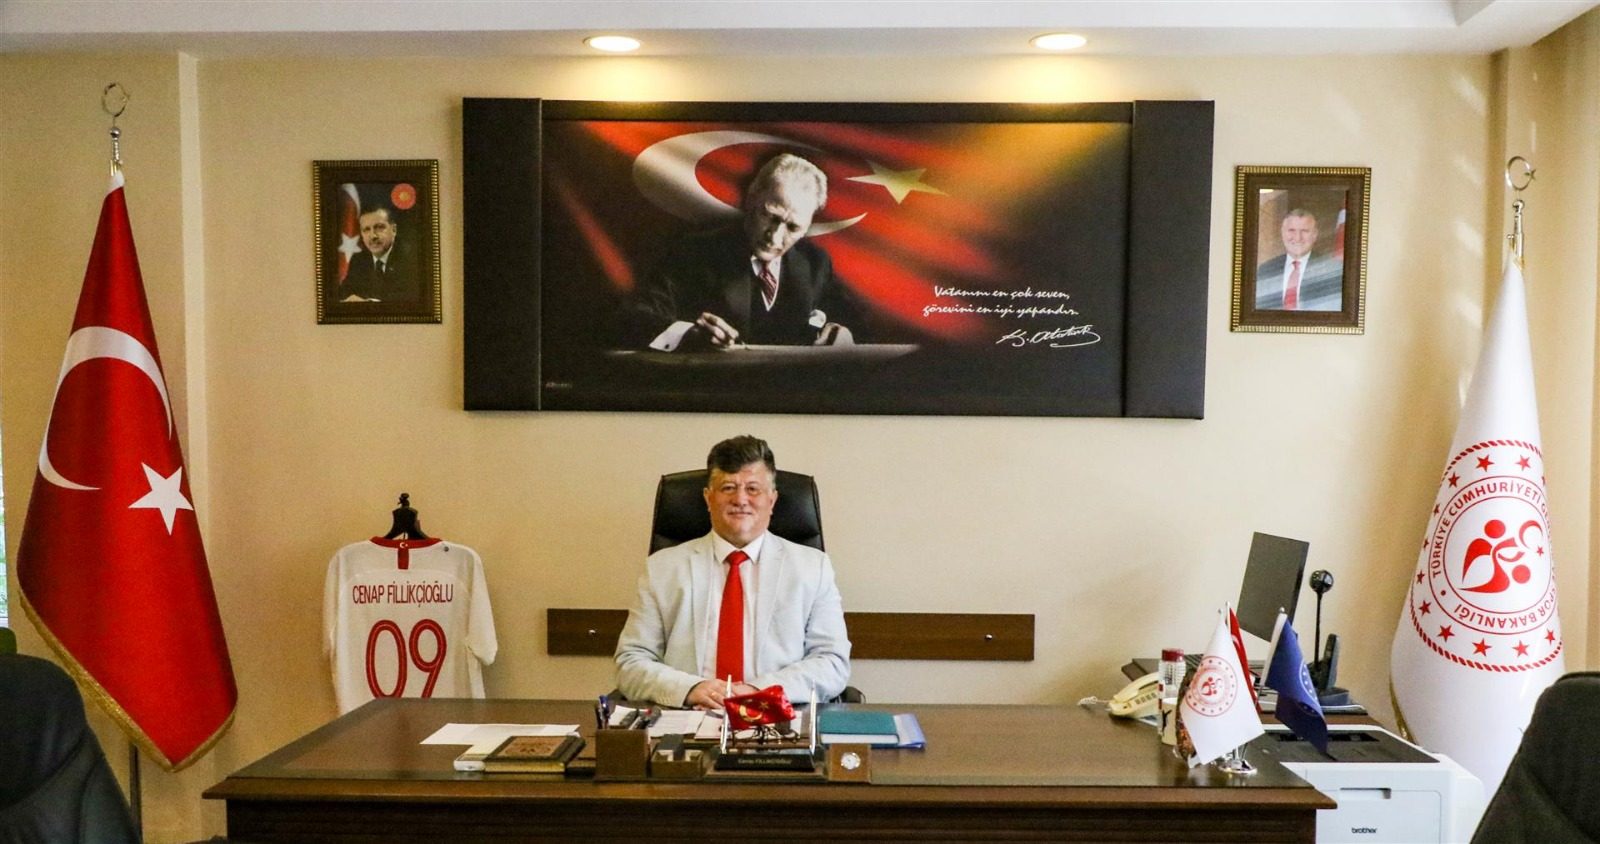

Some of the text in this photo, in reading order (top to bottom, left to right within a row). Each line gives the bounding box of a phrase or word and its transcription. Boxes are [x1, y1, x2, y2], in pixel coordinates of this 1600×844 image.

[992, 289, 1008, 297] en
[1010, 286, 1033, 300] çok
[1034, 290, 1070, 300] seven,
[922, 303, 975, 317] görevini
[976, 306, 992, 314] en
[993, 304, 1015, 318] iyi
[1430, 518, 1451, 579] TÜRKİYE
[1454, 604, 1537, 628] BAKANLIĞI
[352, 580, 454, 608] CENAP FİLLİKÇİOĞLU
[365, 618, 447, 699] 09
